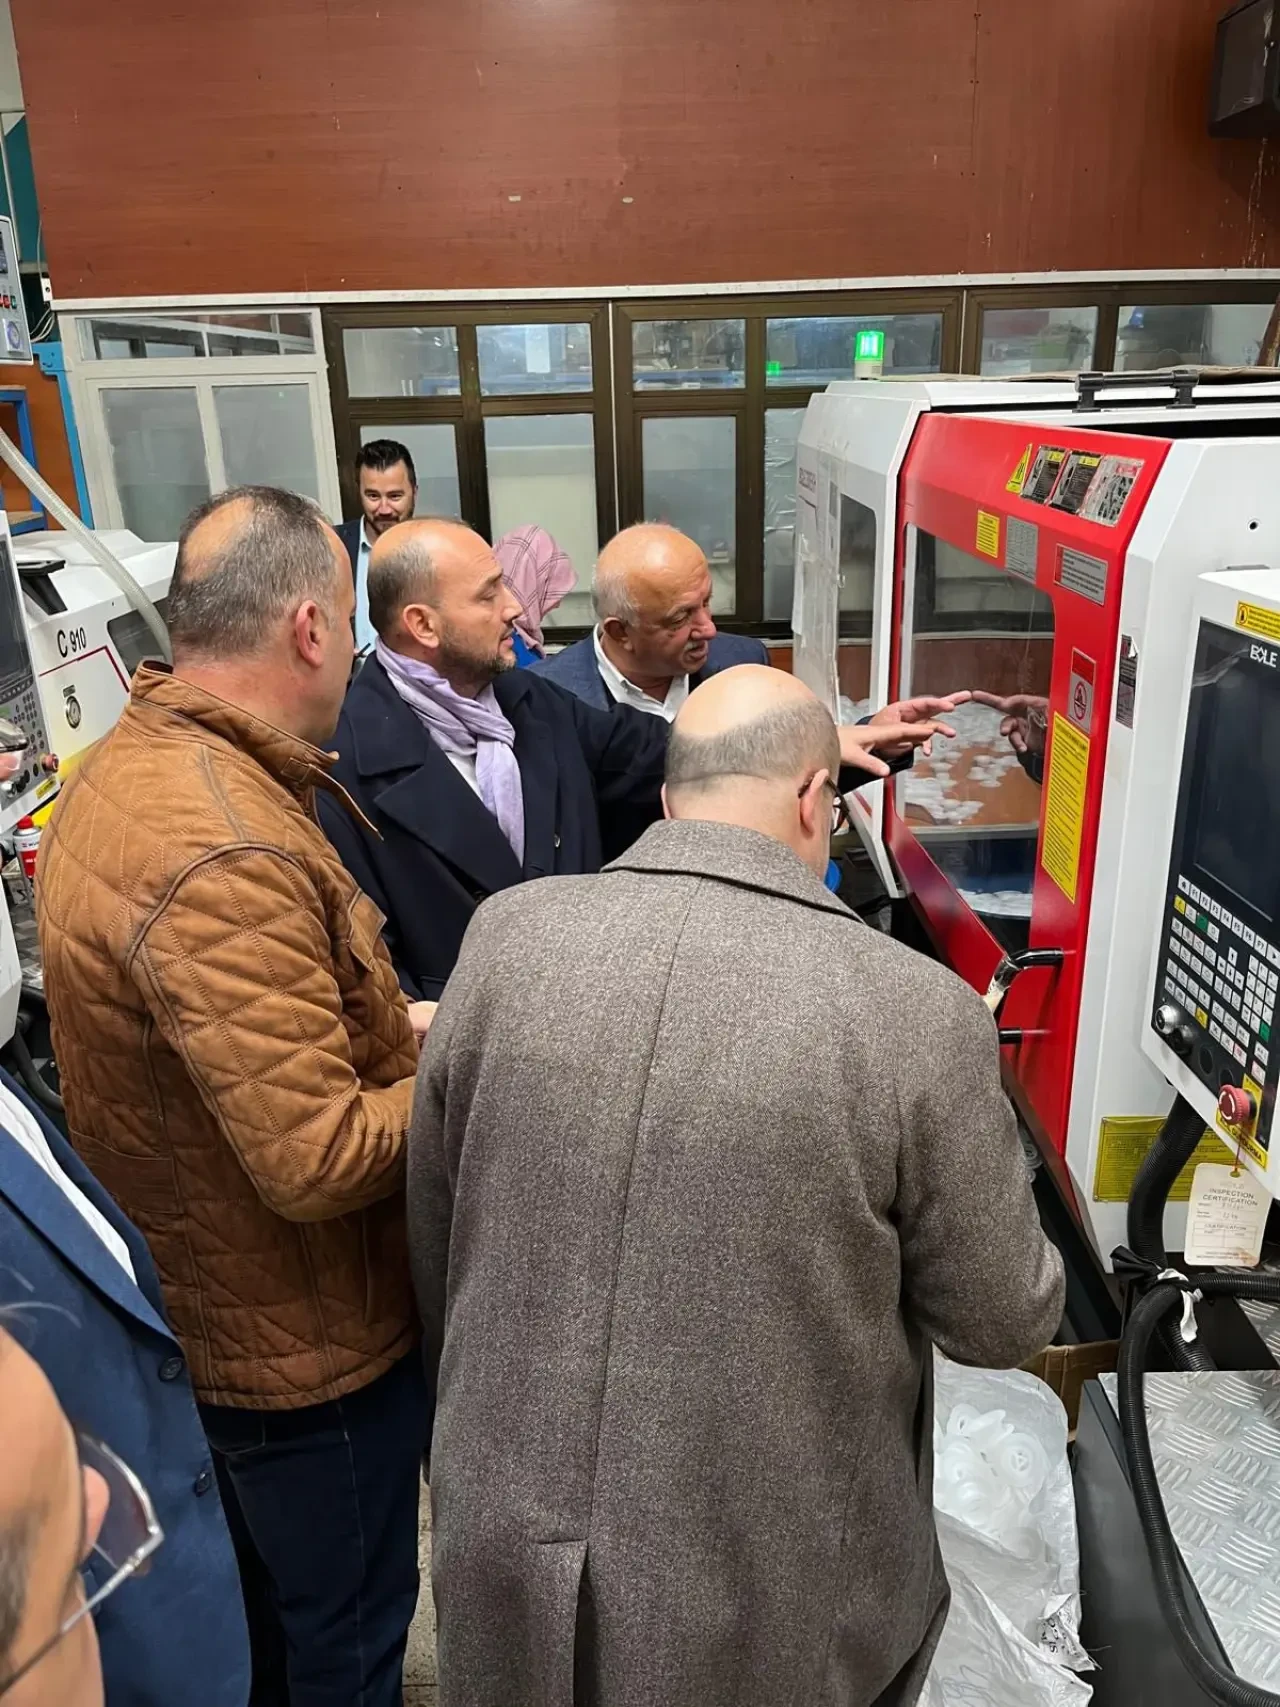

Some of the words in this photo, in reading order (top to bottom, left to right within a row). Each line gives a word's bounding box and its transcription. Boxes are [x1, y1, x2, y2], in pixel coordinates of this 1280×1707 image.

[57, 629, 68, 658] C
[70, 627, 86, 653] 910
[1209, 1188, 1255, 1199] INSPECTION
[1202, 1194, 1259, 1206] CERTIFICATION
